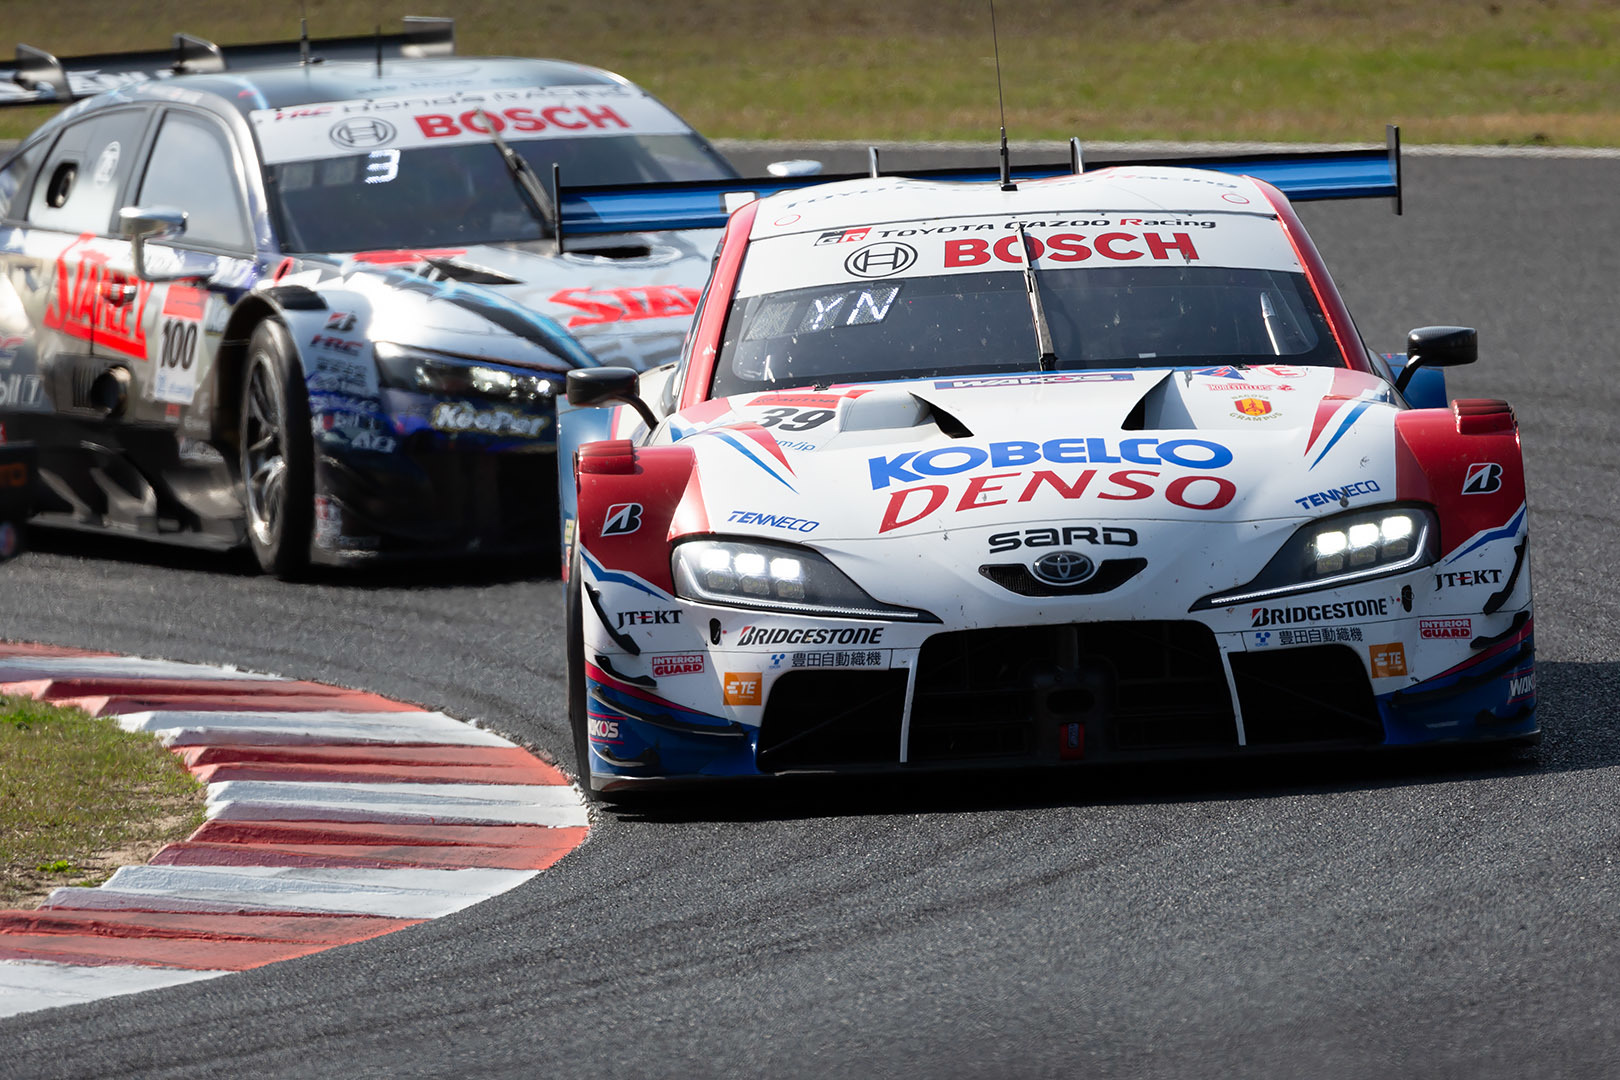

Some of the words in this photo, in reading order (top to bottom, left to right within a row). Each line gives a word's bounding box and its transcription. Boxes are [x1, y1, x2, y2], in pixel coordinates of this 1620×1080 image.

[414, 105, 629, 139] BOSCH
[365, 149, 401, 184] 3
[878, 223, 995, 238] TOYOTA
[1004, 218, 1111, 230] GAZOO
[1119, 218, 1217, 229] Racing
[943, 231, 1200, 269] BOSCH
[160, 317, 199, 370] 100
[761, 407, 837, 432] 39
[868, 438, 1234, 490] KOBELCO
[878, 470, 1237, 534] DENSO
[1295, 480, 1380, 510] TENNECO
[727, 510, 820, 533] TENNECO
[1435, 569, 1502, 591] JTEKT
[617, 609, 683, 629] JTEKT
[1252, 598, 1388, 628] BRIDGESTONE
[1420, 619, 1471, 630] INTERIOR
[1422, 628, 1470, 639] GUARD
[737, 626, 884, 647] BRIDGESTONE
[652, 656, 703, 666] INTERIOR
[1388, 651, 1402, 666] TE
[654, 665, 703, 676] GUARD
[741, 681, 757, 694] TE
